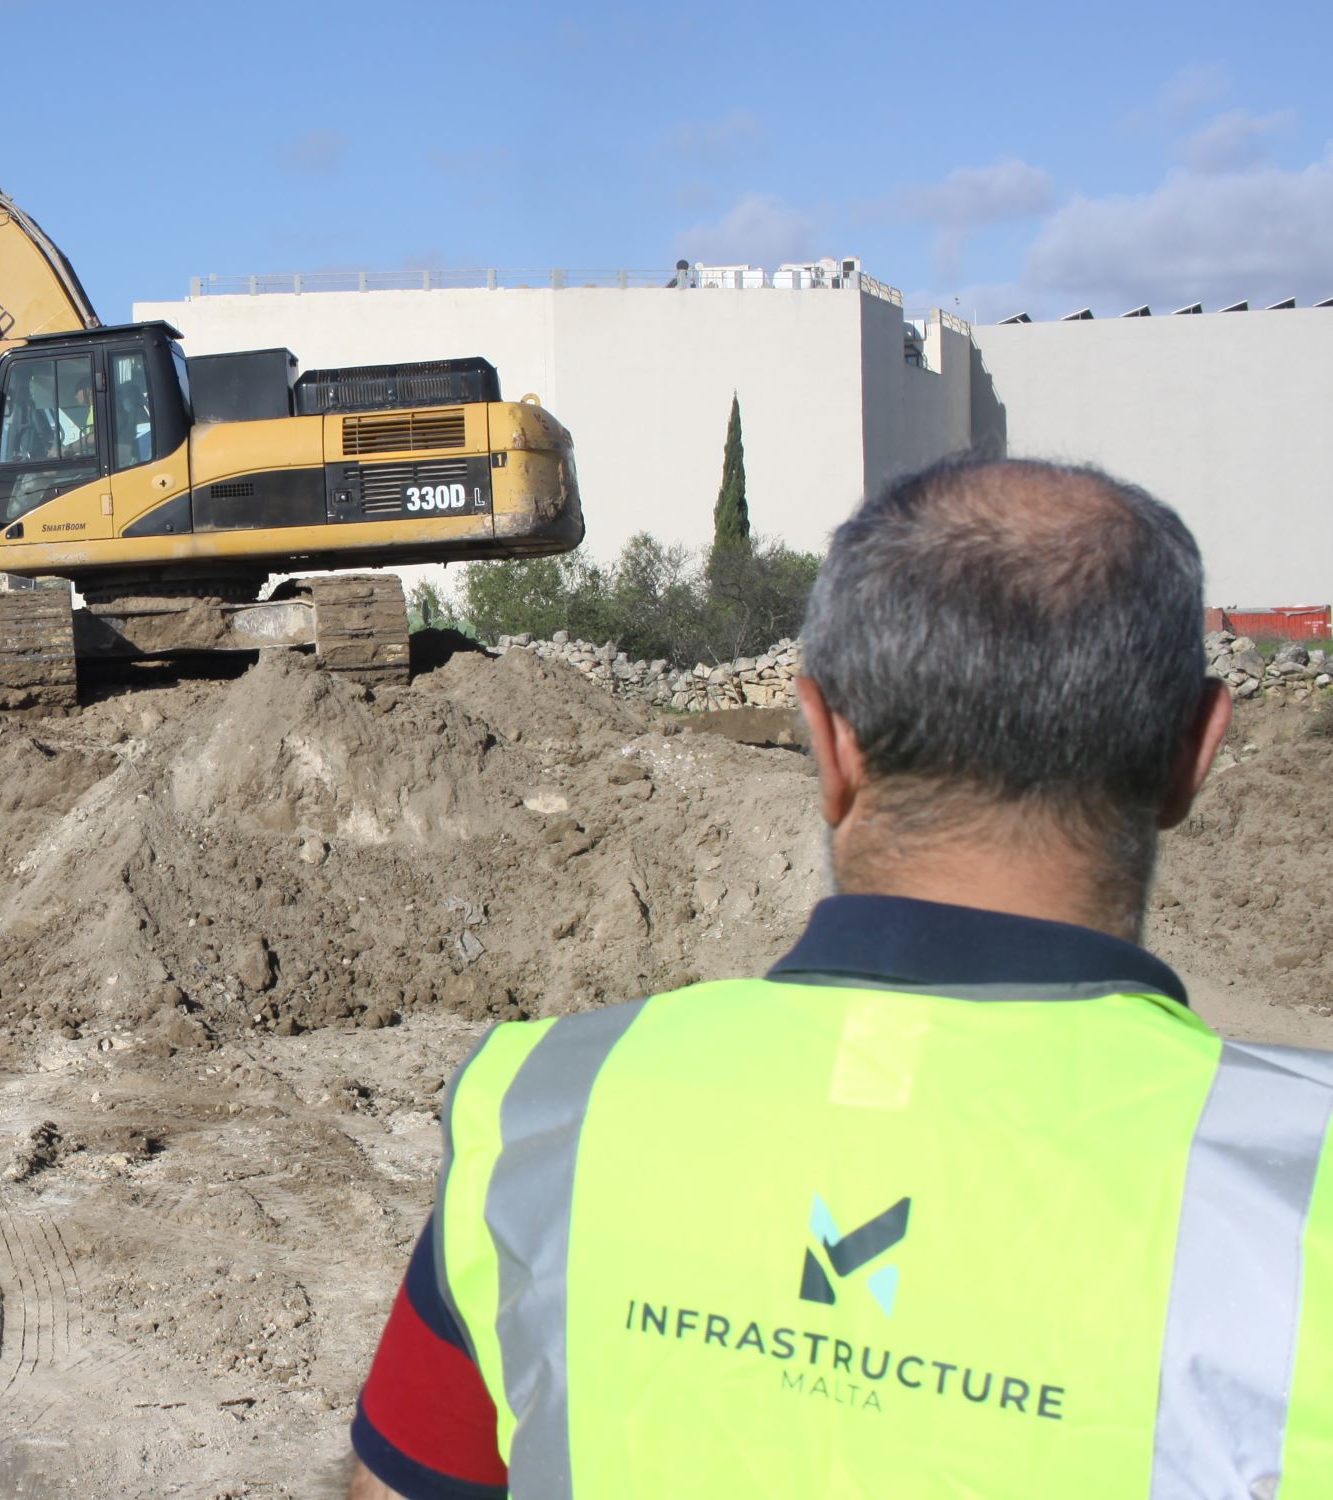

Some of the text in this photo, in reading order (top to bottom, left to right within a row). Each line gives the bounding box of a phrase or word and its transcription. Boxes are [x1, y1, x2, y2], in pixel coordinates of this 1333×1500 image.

[406, 484, 485, 511] 330D L
[625, 1300, 1065, 1420] INFRASTRUCTURE
[781, 1370, 881, 1412] MALTA
